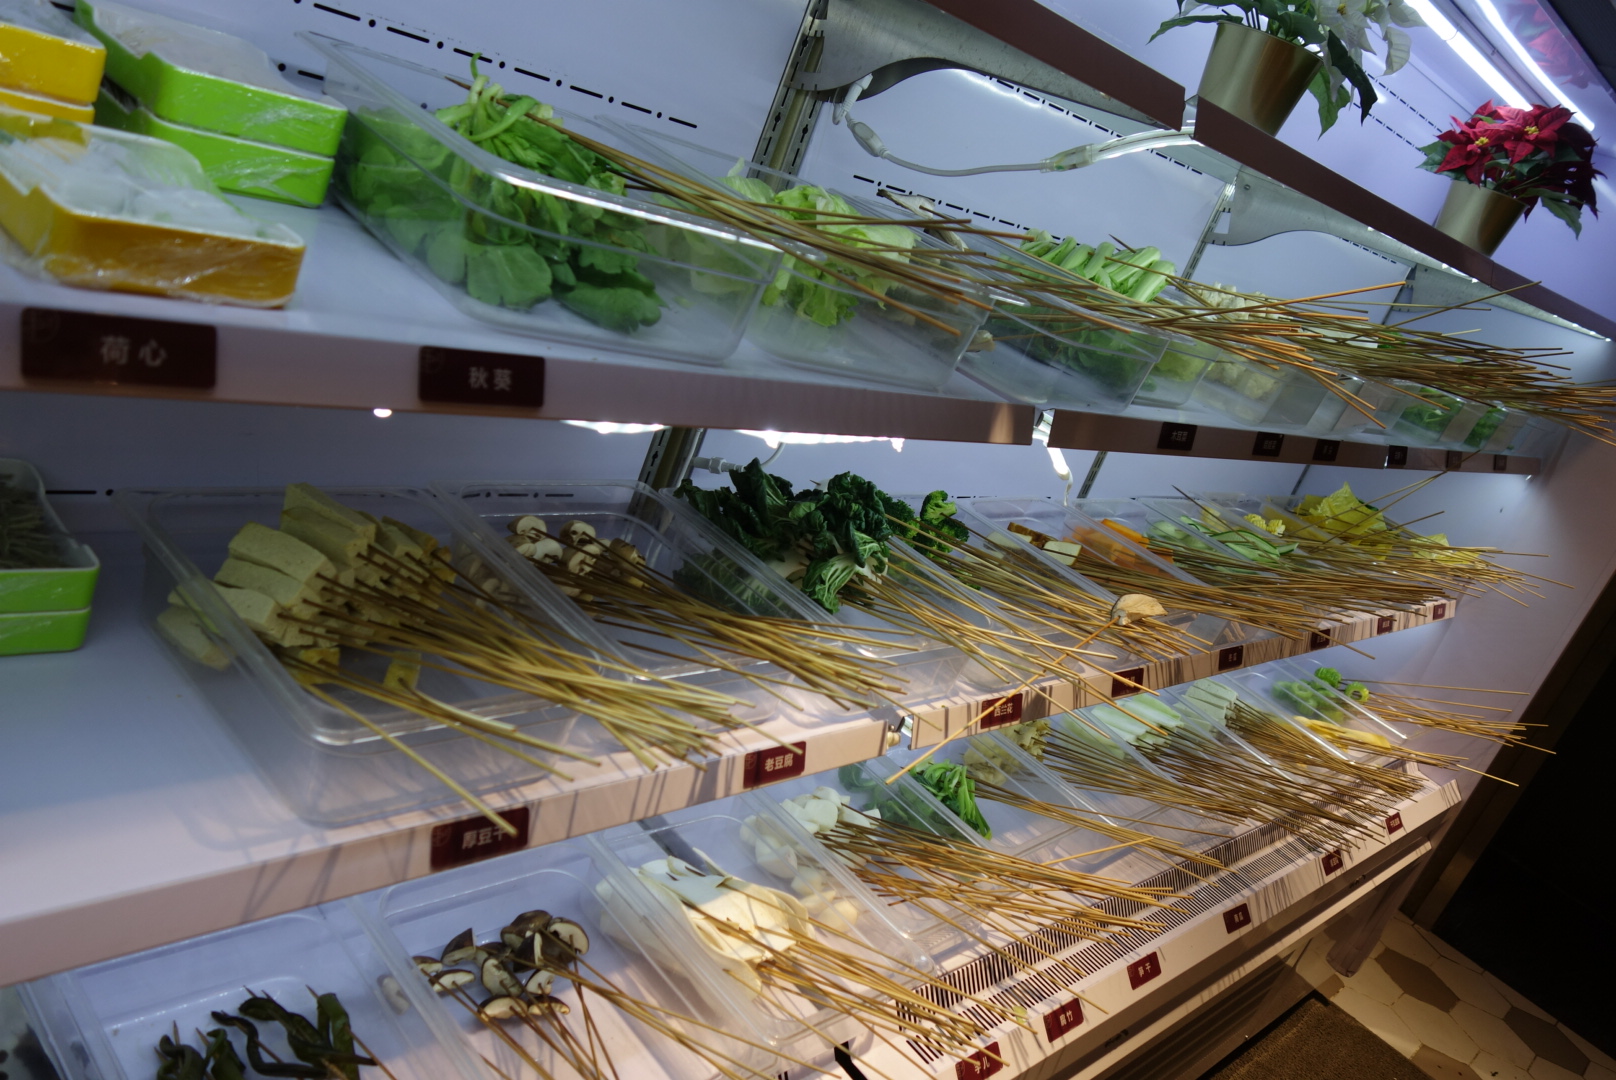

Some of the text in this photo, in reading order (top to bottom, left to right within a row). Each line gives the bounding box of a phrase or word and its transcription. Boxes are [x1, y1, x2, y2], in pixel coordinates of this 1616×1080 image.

[100, 335, 168, 368] 荷心
[468, 366, 513, 391] 秋葵
[994, 702, 1014, 718] 西兰花
[764, 752, 793, 773] 老豆腐
